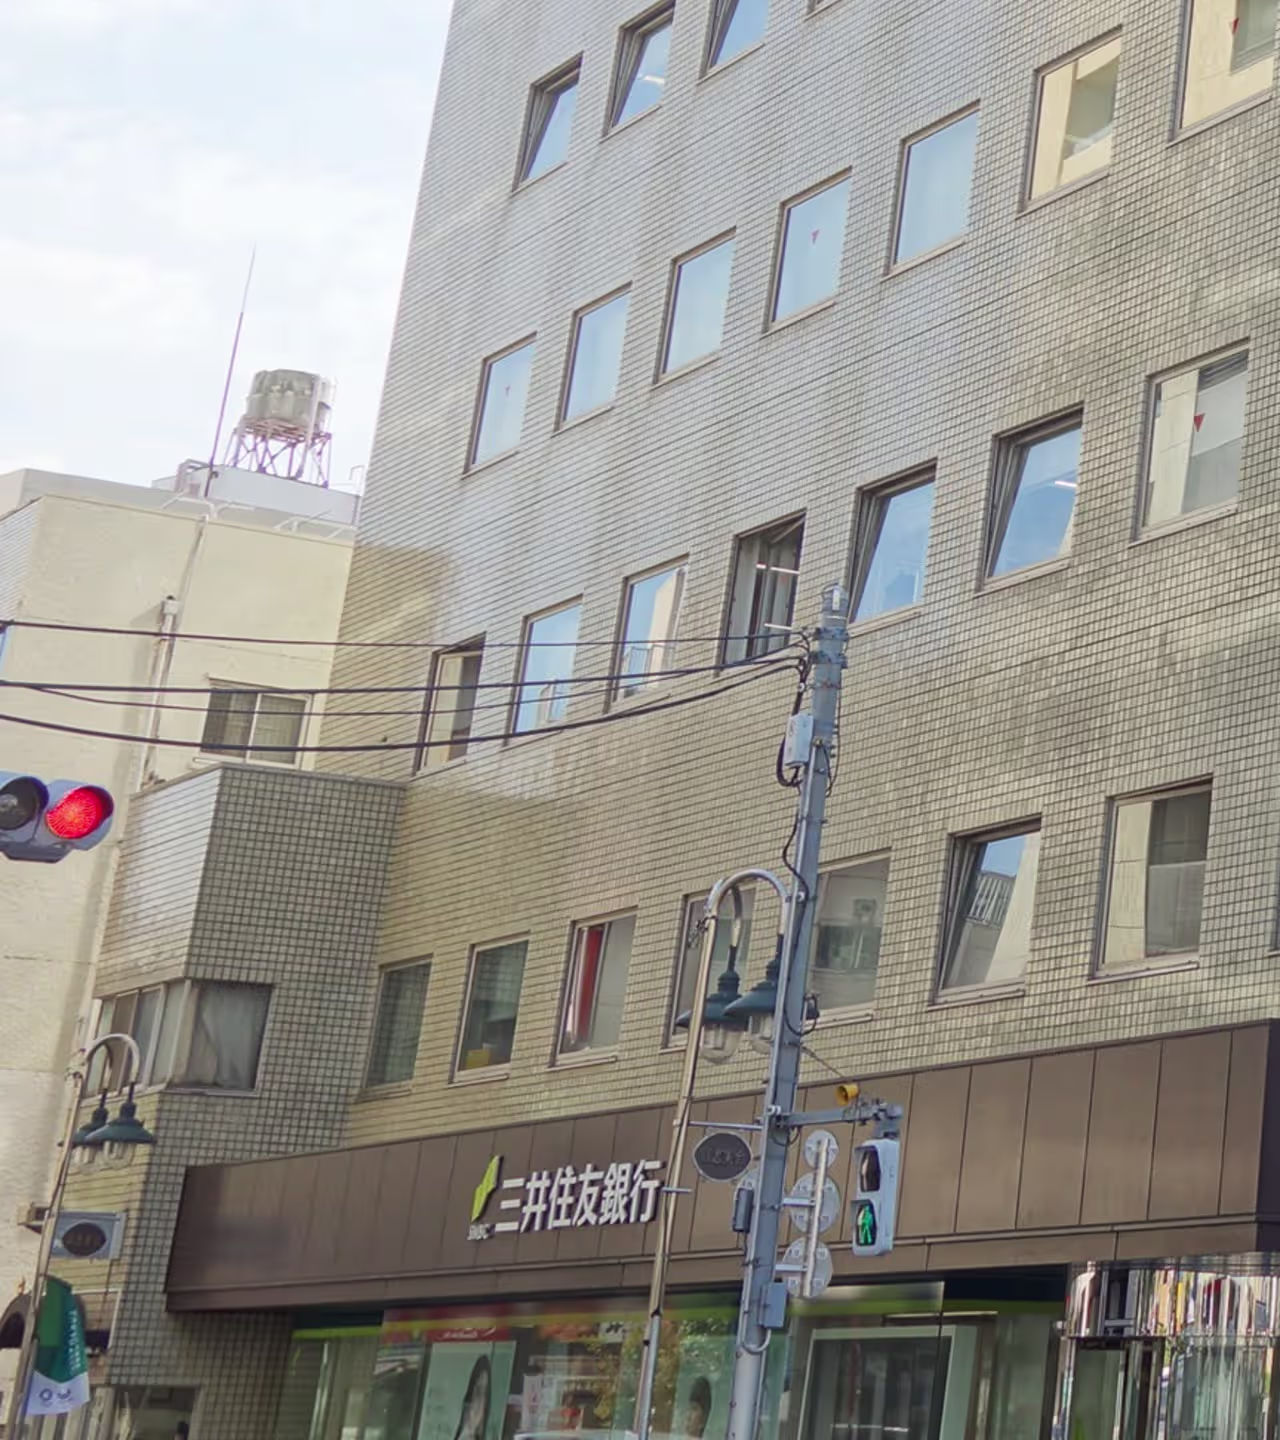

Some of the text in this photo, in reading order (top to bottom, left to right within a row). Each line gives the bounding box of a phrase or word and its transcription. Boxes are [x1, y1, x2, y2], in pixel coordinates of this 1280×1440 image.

[494, 1159, 662, 1234] 三井住友銀行
